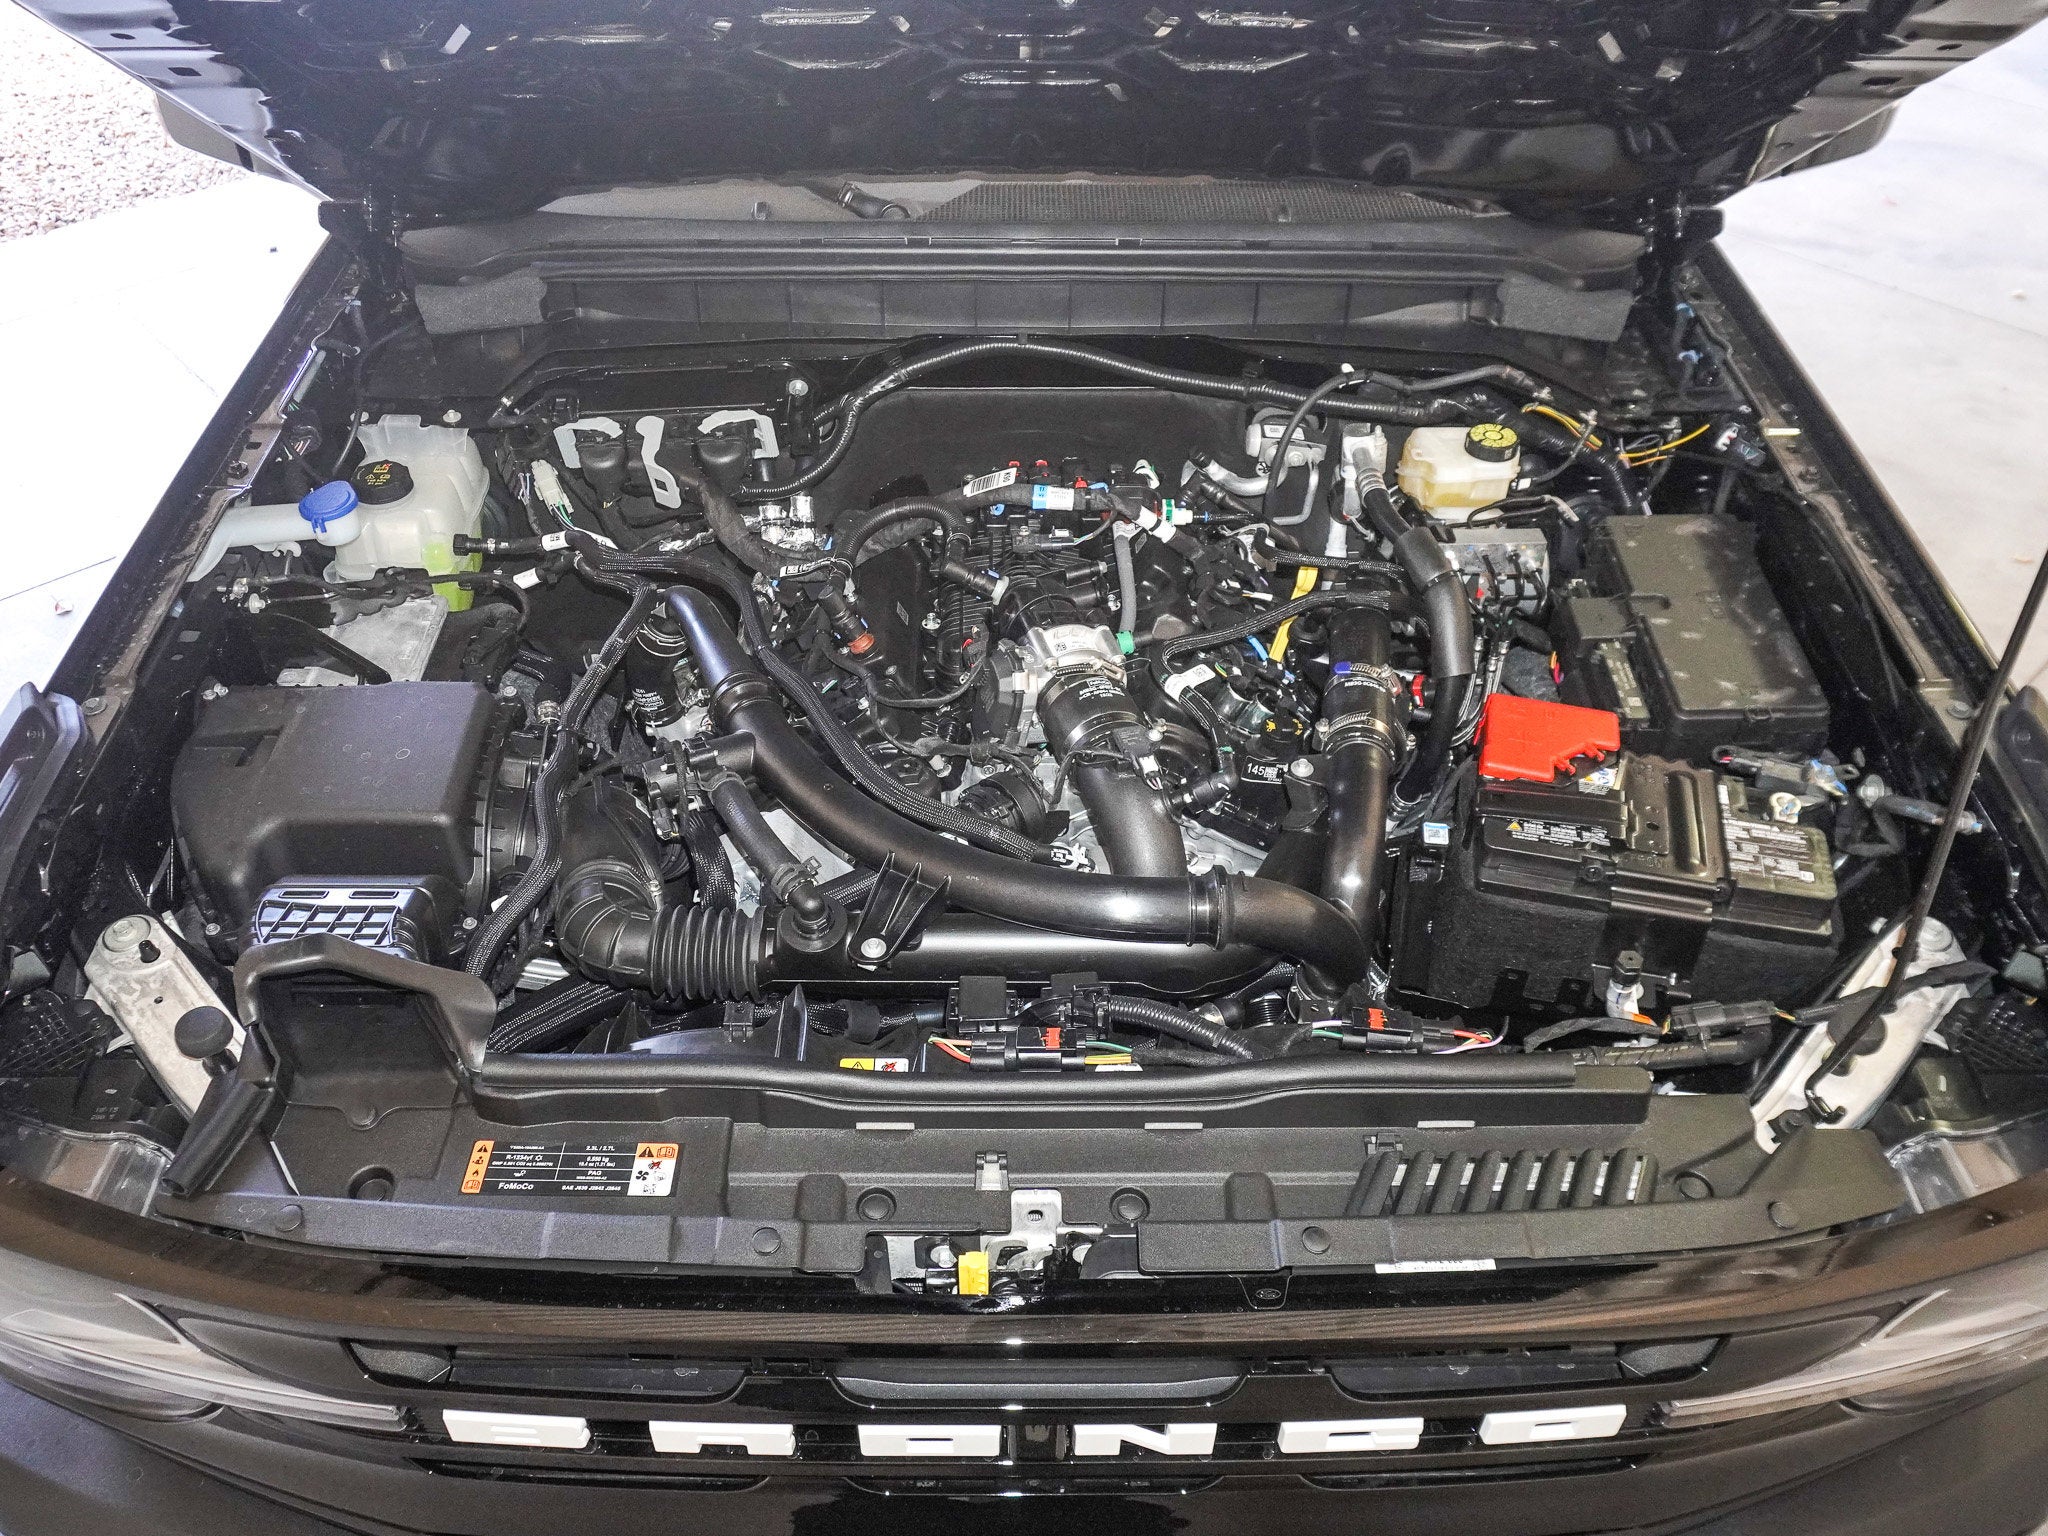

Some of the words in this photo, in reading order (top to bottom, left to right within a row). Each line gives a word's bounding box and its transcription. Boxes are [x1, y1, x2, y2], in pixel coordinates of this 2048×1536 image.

[1247, 762, 1266, 776] 145
[506, 1154, 533, 1162] R-1234yf
[498, 1182, 534, 1190] FoMoCo
[443, 1404, 1628, 1457] BRONCO
